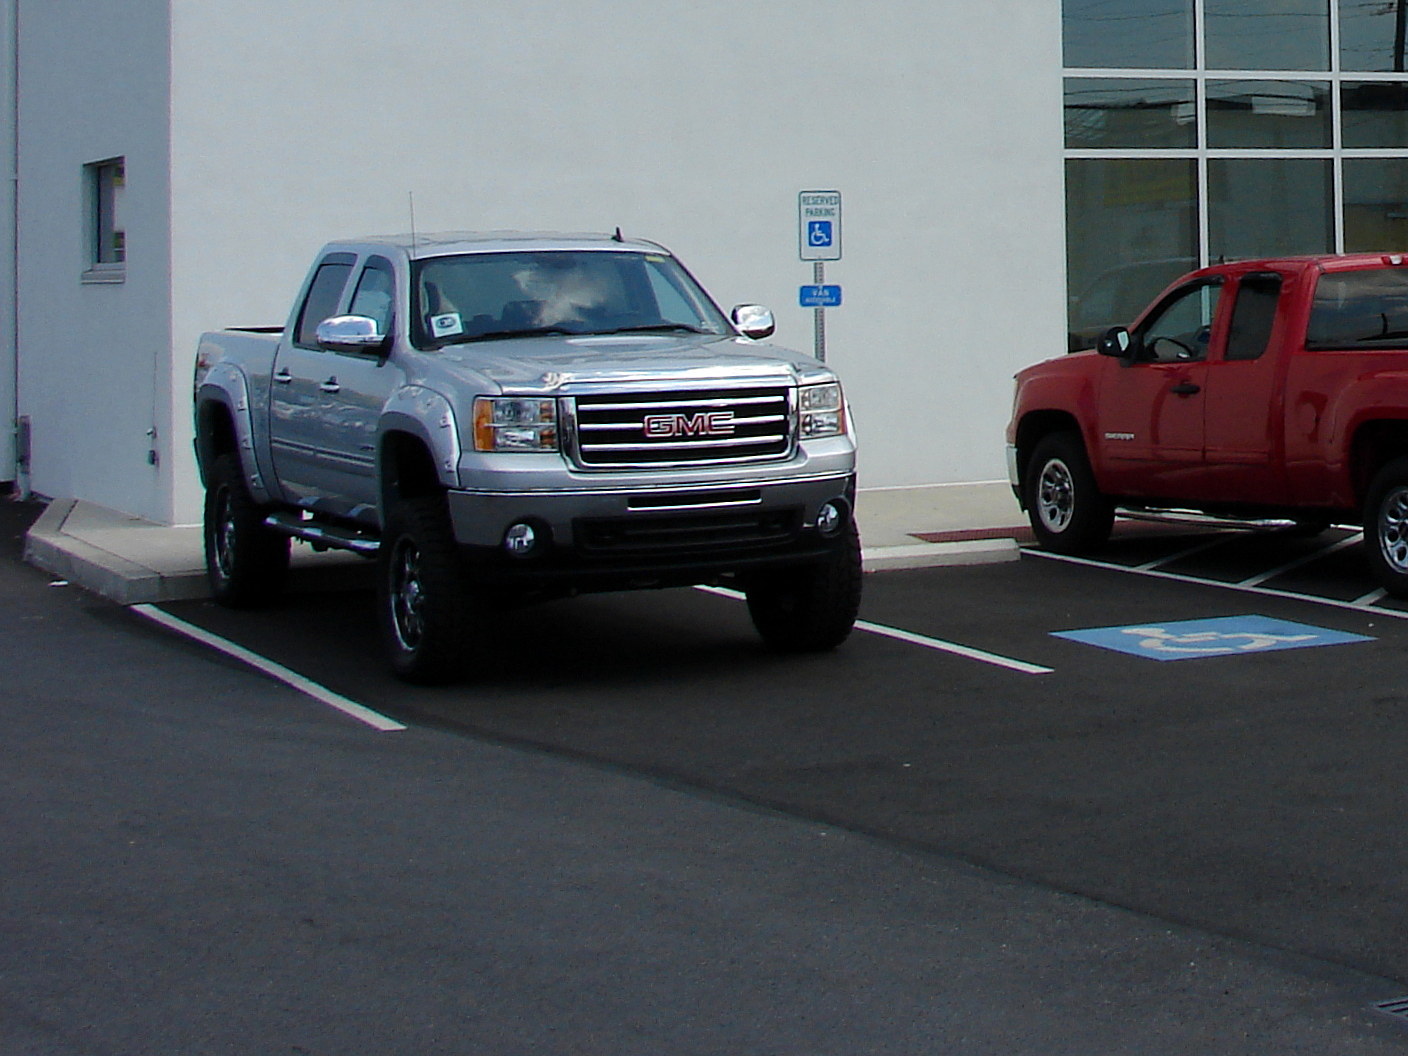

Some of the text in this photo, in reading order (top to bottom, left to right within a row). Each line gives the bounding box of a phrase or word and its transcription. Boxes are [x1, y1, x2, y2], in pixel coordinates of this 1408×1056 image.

[802, 196, 839, 206] RESERVED
[805, 208, 836, 217] PARKING
[644, 411, 736, 438] GMC
